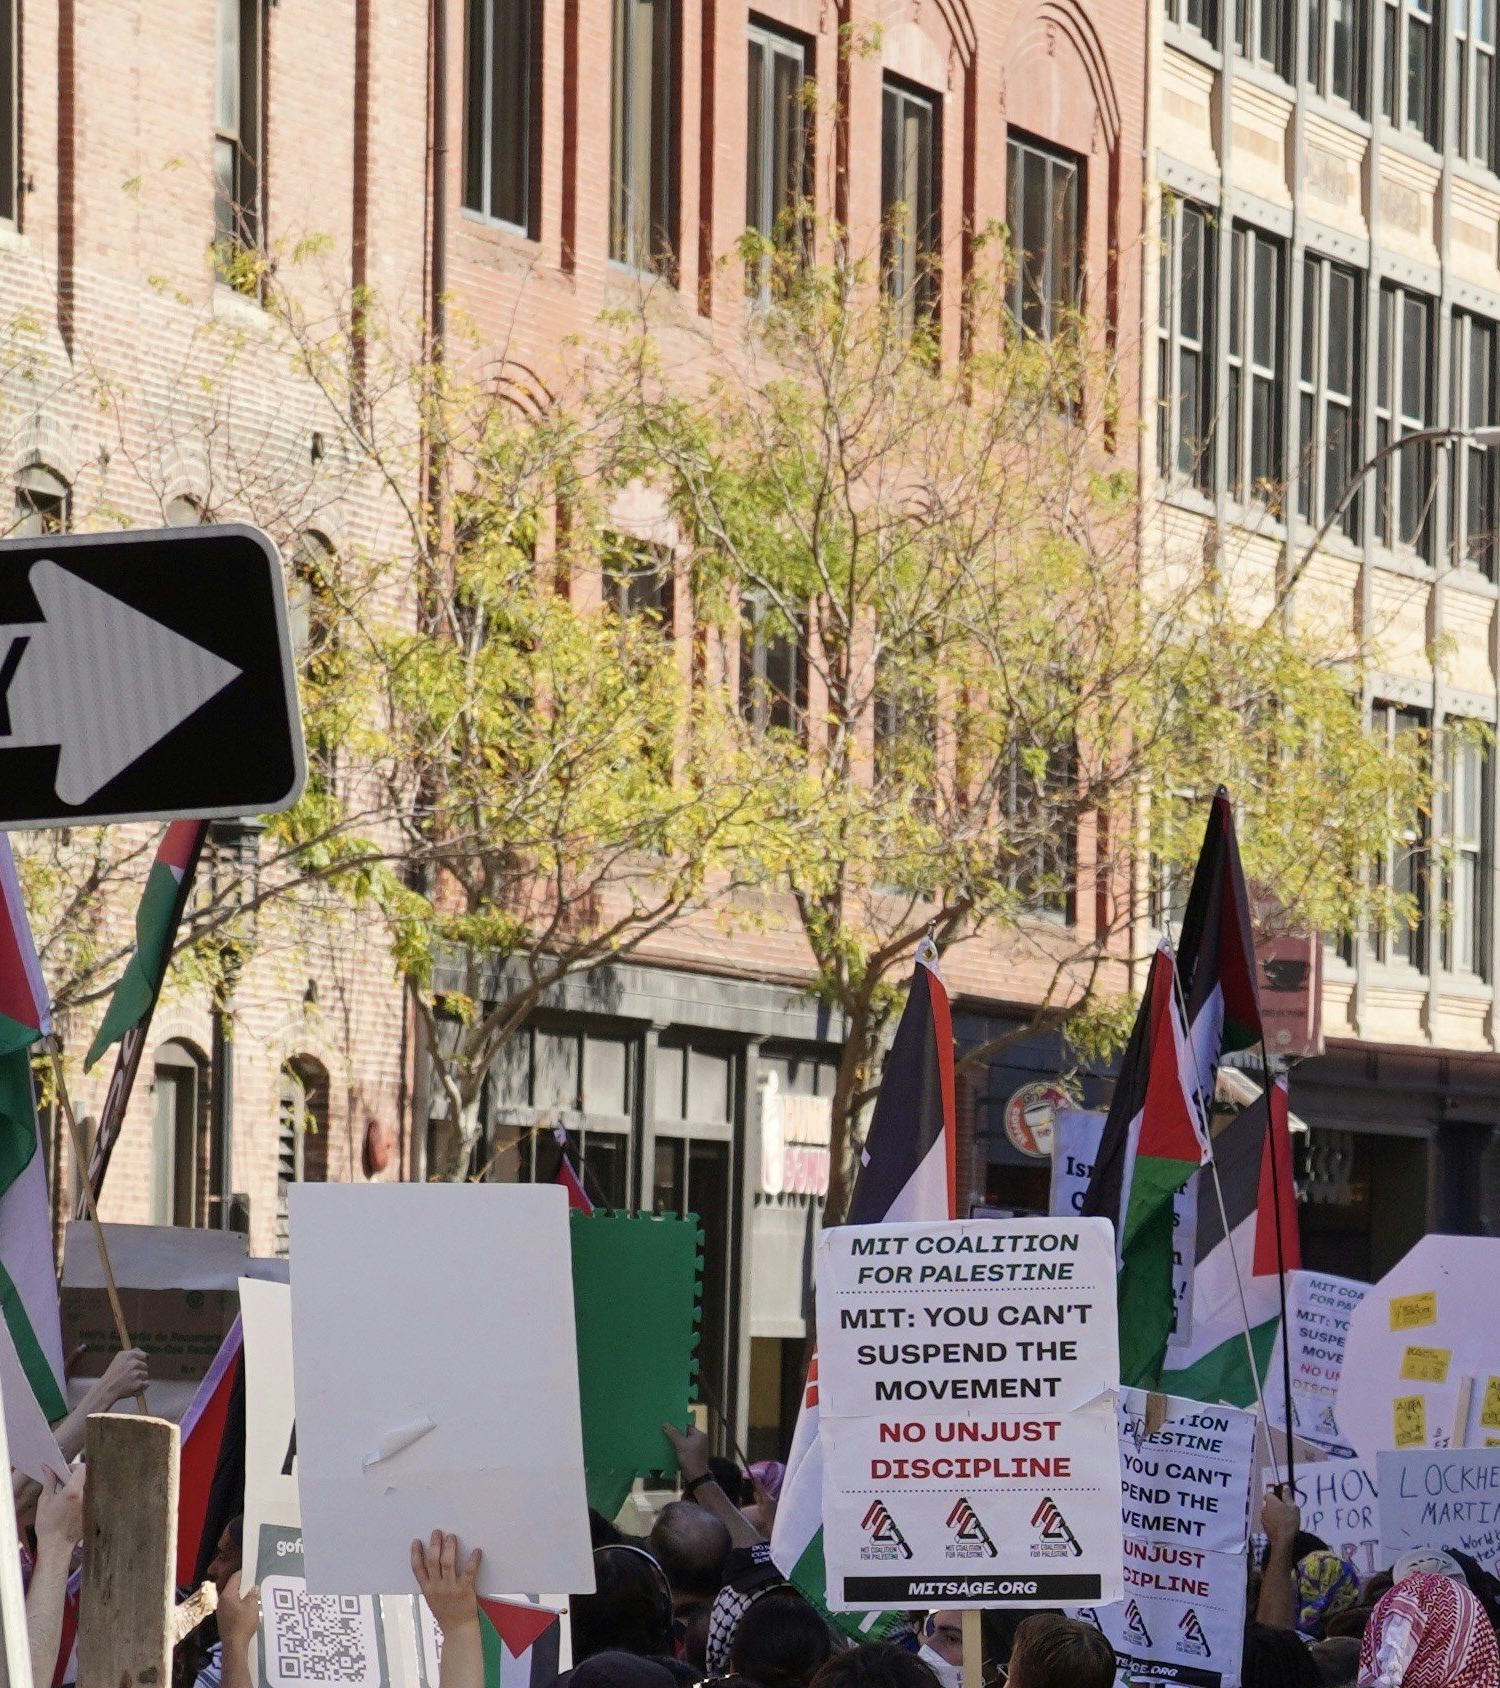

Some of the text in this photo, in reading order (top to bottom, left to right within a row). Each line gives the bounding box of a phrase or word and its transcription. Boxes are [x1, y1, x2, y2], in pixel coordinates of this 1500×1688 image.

[851, 1234, 1079, 1256] MIT COALITION
[858, 1263, 1074, 1284] FOR PALESTINE
[1310, 1279, 1336, 1293] MIT
[1309, 1293, 1335, 1308] FOR
[840, 1304, 1092, 1329] MIT: YOU CAN'T
[1296, 1309, 1350, 1332] MIT: YO
[1300, 1327, 1346, 1347] SUSPE
[857, 1341, 1078, 1365] SUSPEND THE
[1302, 1345, 1344, 1364] MOVE
[1300, 1363, 1321, 1378] NO
[875, 1377, 1062, 1401] MOVEMENT
[879, 1421, 1061, 1443] NO UNJUST
[871, 1457, 1071, 1479] DISCIPLINE
[1124, 1454, 1232, 1488] YOU CAN'T
[1122, 1480, 1219, 1513] PEND THE
[1122, 1508, 1206, 1537] VEMENT
[1336, 1507, 1372, 1529] FOR
[1124, 1540, 1205, 1570] UNJUST
[908, 1581, 1038, 1597] MITSAGE.ORG
[1123, 1566, 1209, 1597] CIPLINE
